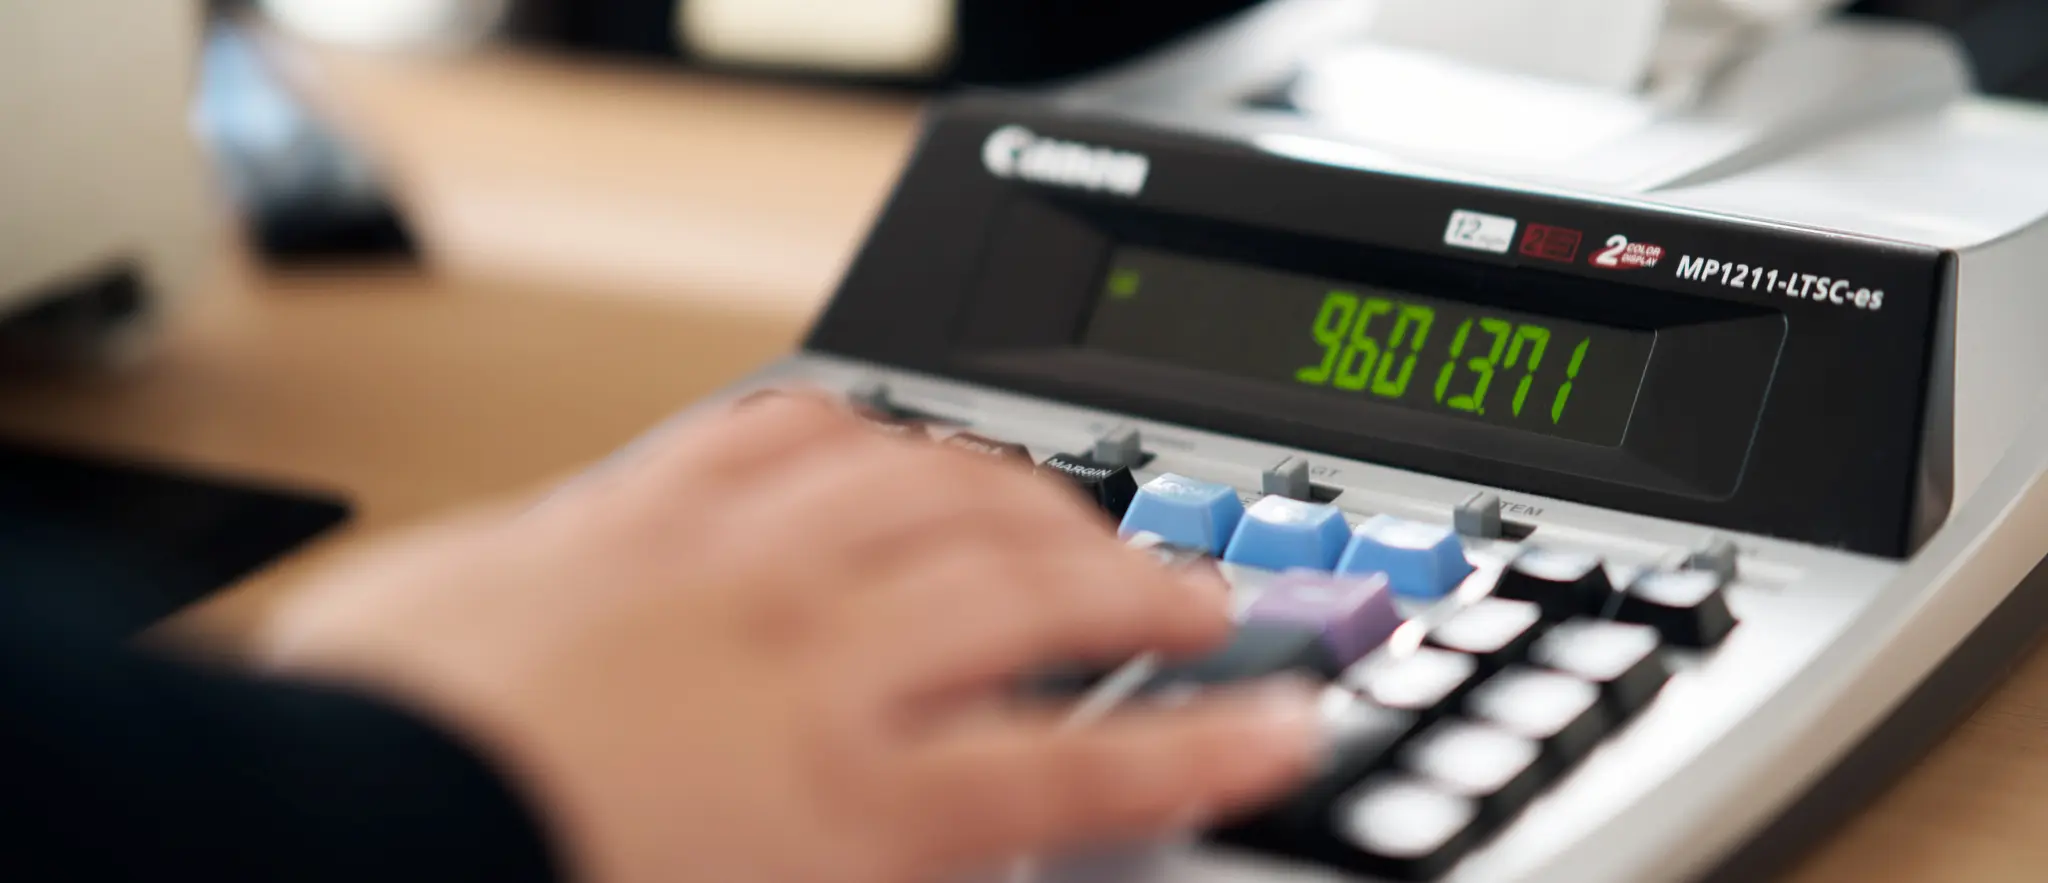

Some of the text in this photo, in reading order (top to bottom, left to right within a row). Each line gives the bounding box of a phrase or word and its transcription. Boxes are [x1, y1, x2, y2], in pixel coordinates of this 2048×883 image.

[981, 124, 1150, 195] Canon
[1453, 217, 1481, 240] 12
[1597, 234, 1627, 266] 2
[1627, 243, 1661, 256] COLOR
[1621, 252, 1656, 267] DISPLAY
[1675, 254, 1884, 310] MP1211-LTSC-es
[1047, 457, 1112, 478] MARGIN
